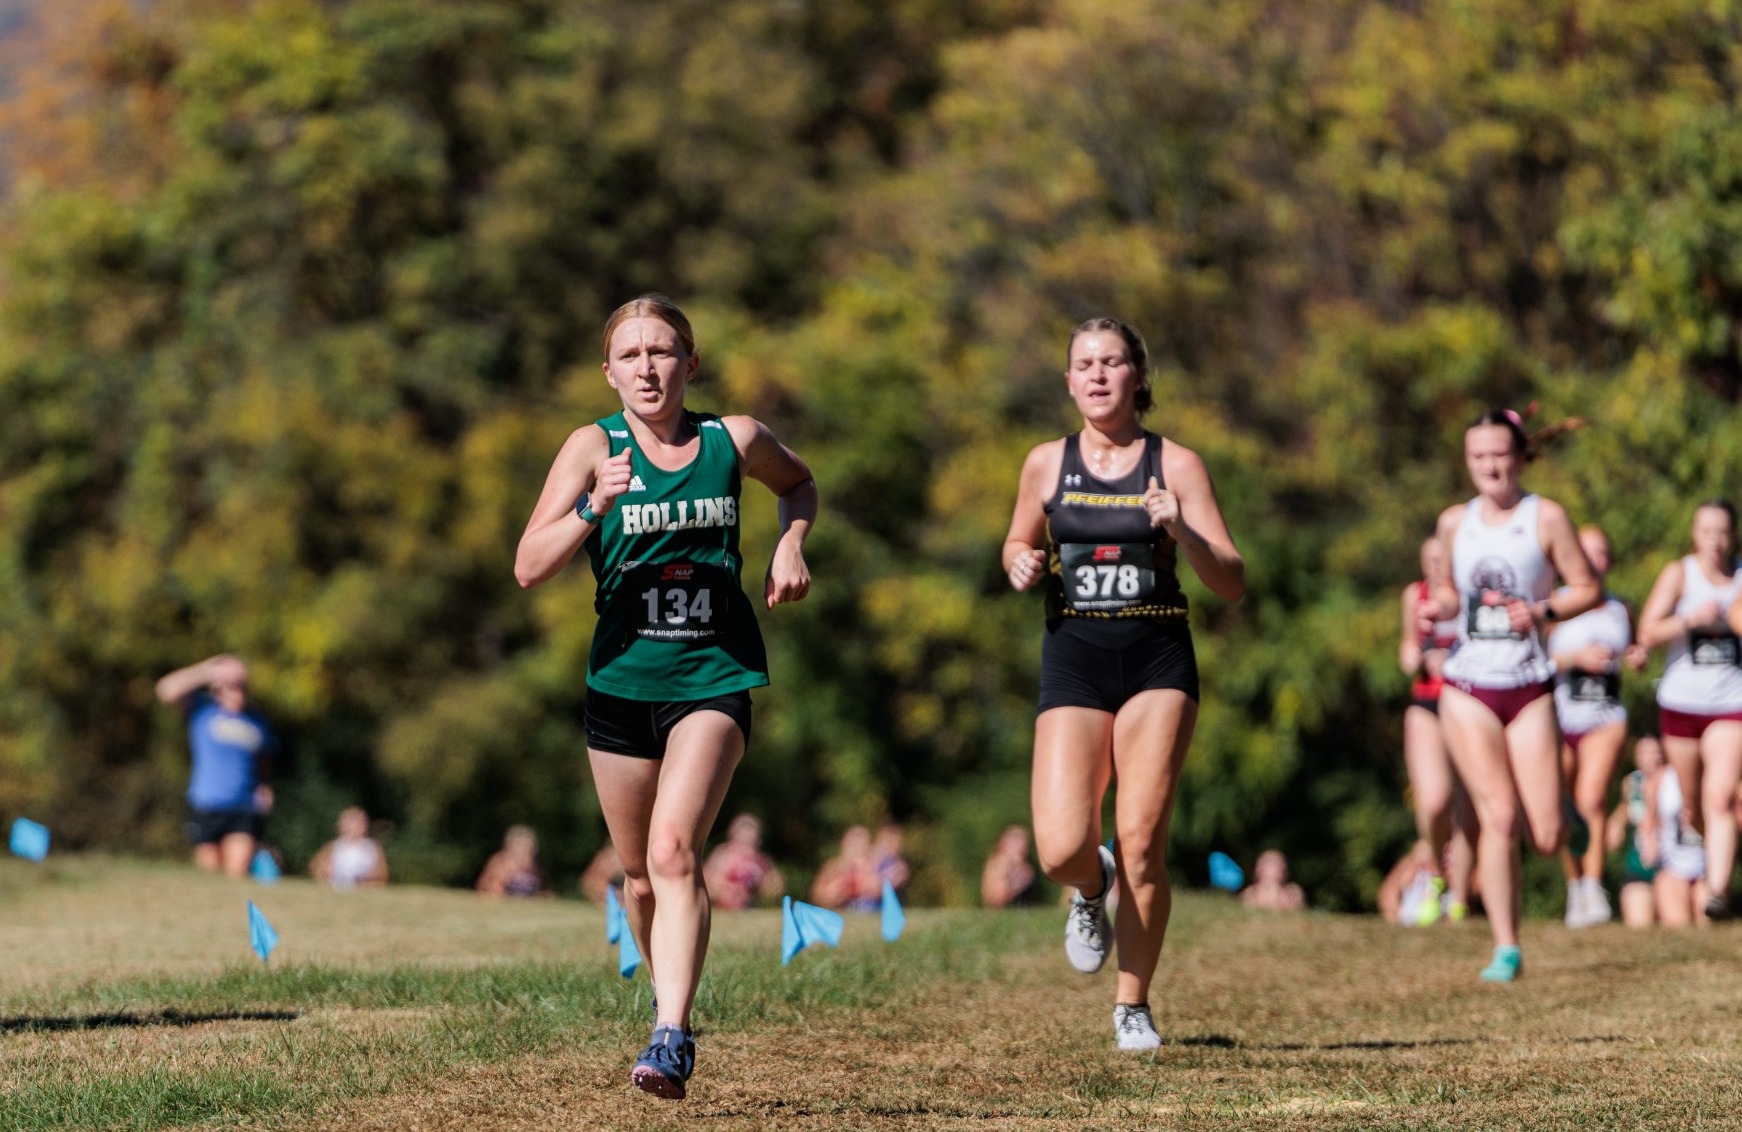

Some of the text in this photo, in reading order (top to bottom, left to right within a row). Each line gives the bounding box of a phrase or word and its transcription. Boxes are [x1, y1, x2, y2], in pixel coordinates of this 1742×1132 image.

[621, 496, 736, 534] HOLLINS
[660, 564, 694, 580] SNAP
[1075, 564, 1140, 598] 378
[642, 587, 713, 624] 134
[637, 628, 715, 639] www.snaptiming.com
